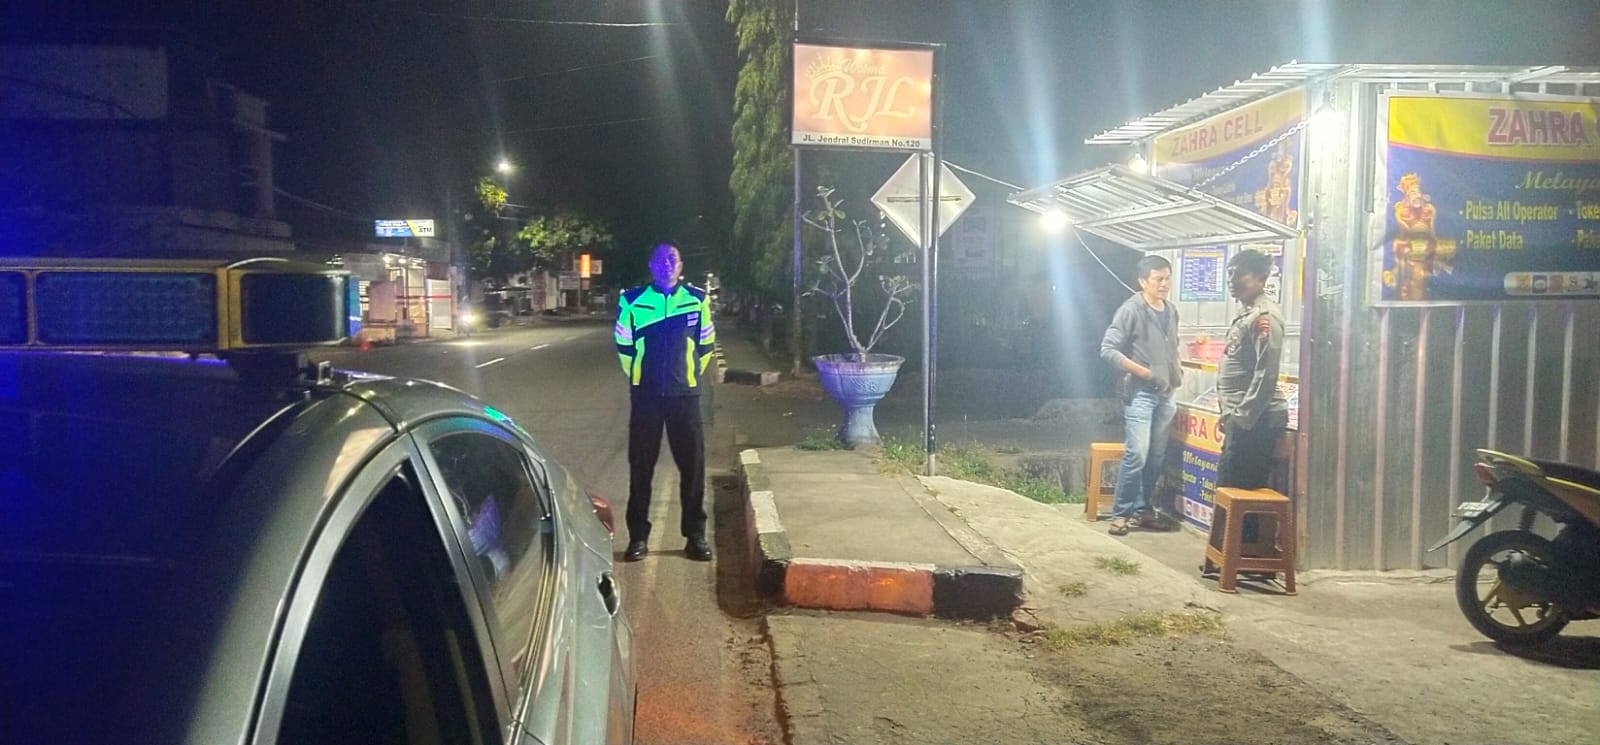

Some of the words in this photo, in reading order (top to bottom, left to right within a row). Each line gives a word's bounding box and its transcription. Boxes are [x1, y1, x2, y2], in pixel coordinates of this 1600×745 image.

[809, 71, 916, 132] RJL
[1171, 126, 1217, 156] ZAHRA
[1223, 110, 1263, 142] CELL
[1487, 107, 1588, 146] ZAHRA
[818, 135, 849, 144] Jendral
[851, 136, 890, 146] Sudirman
[892, 138, 920, 148] No.120
[1466, 201, 1493, 220] Pulsa
[1496, 201, 1510, 220] All
[1512, 201, 1558, 224] Operator
[1466, 231, 1496, 249] Paket
[1499, 231, 1523, 249] Data
[1176, 411, 1207, 440] HRA
